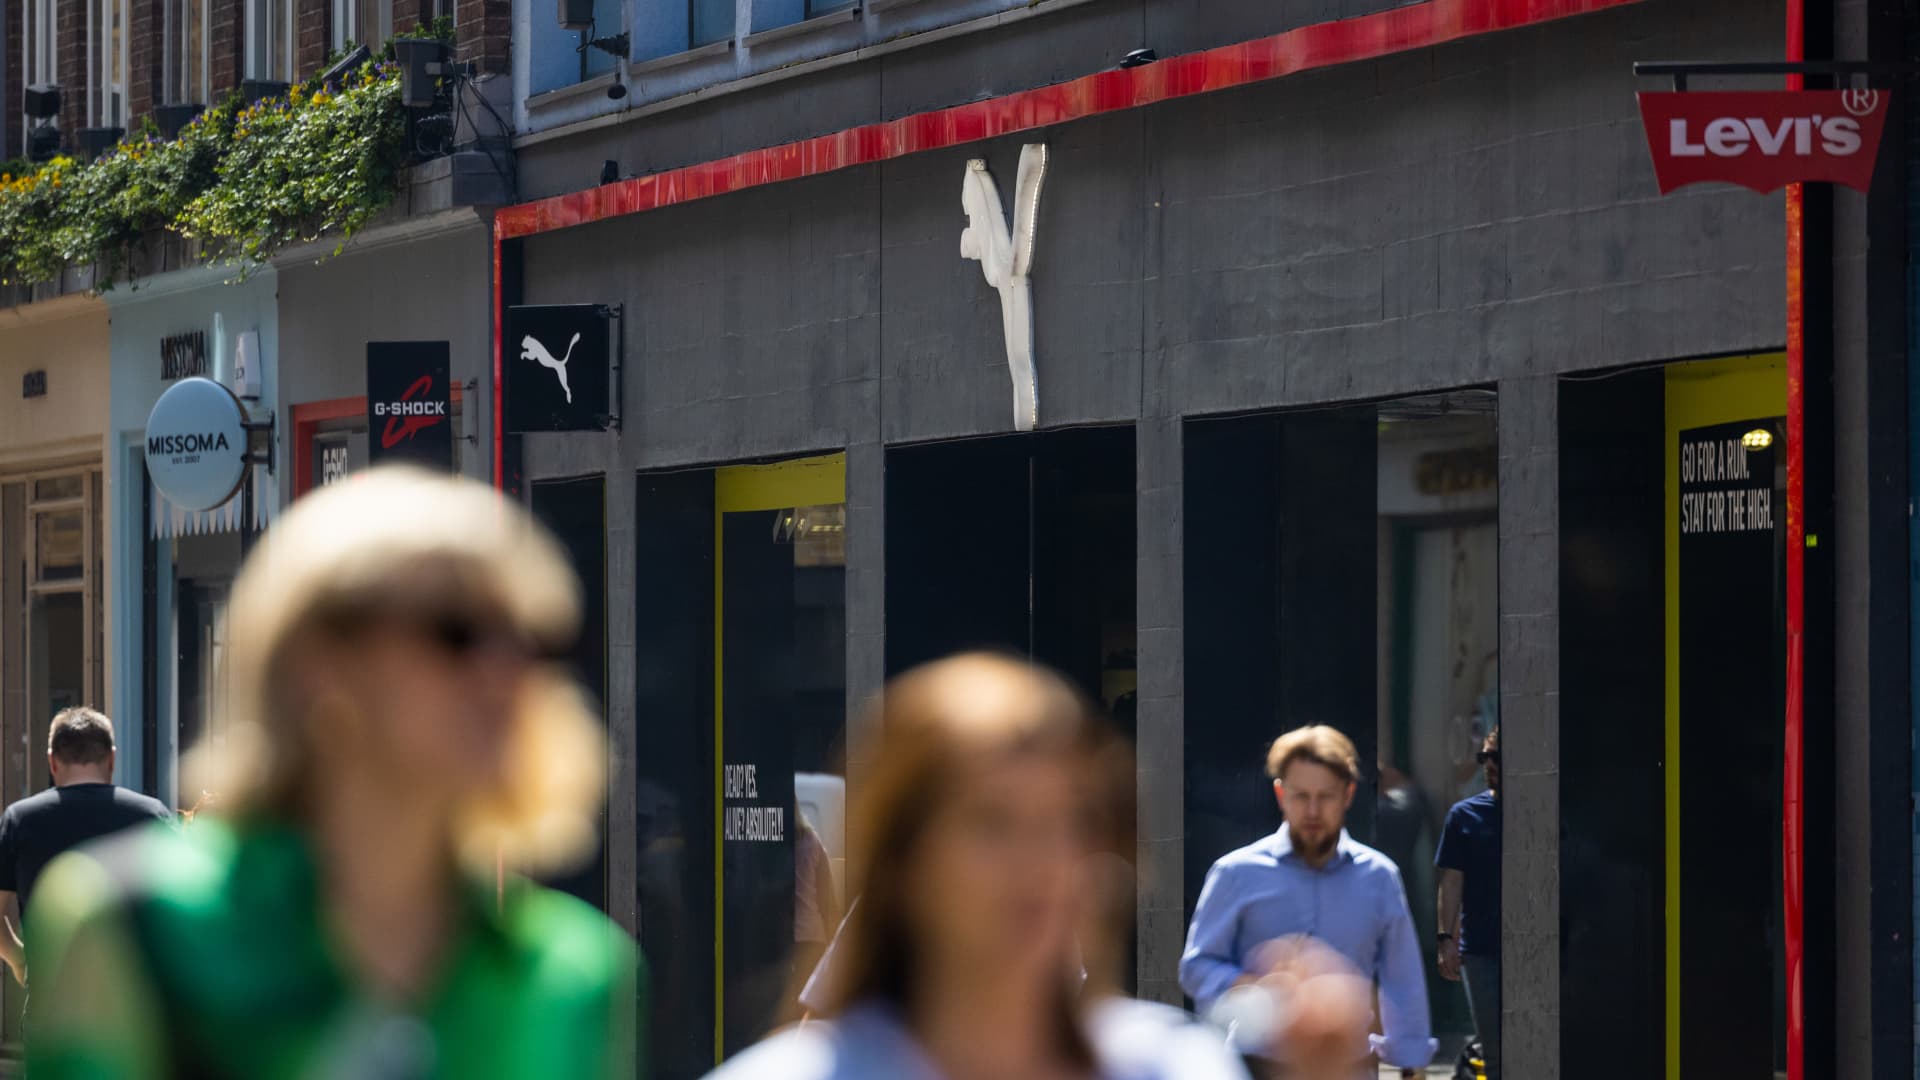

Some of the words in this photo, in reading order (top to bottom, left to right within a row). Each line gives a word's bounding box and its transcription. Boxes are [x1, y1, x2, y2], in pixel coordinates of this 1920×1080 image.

[374, 401, 445, 415] G-SHOCK
[148, 432, 230, 455] MISSOMA
[1682, 442, 1695, 483] GO
[1697, 441, 1716, 482] FOR
[1717, 440, 1725, 481] A
[1727, 439, 1750, 480] RUN.
[1682, 492, 1705, 534] STAY
[1706, 491, 1725, 533] FOR
[1727, 490, 1746, 531] THE
[1747, 488, 1774, 531] HIGH.
[724, 764, 744, 798] DEAD?
[744, 764, 758, 798] YES.
[724, 807, 744, 841] ALIVE?
[745, 807, 784, 841] ABSOLUTELY!
